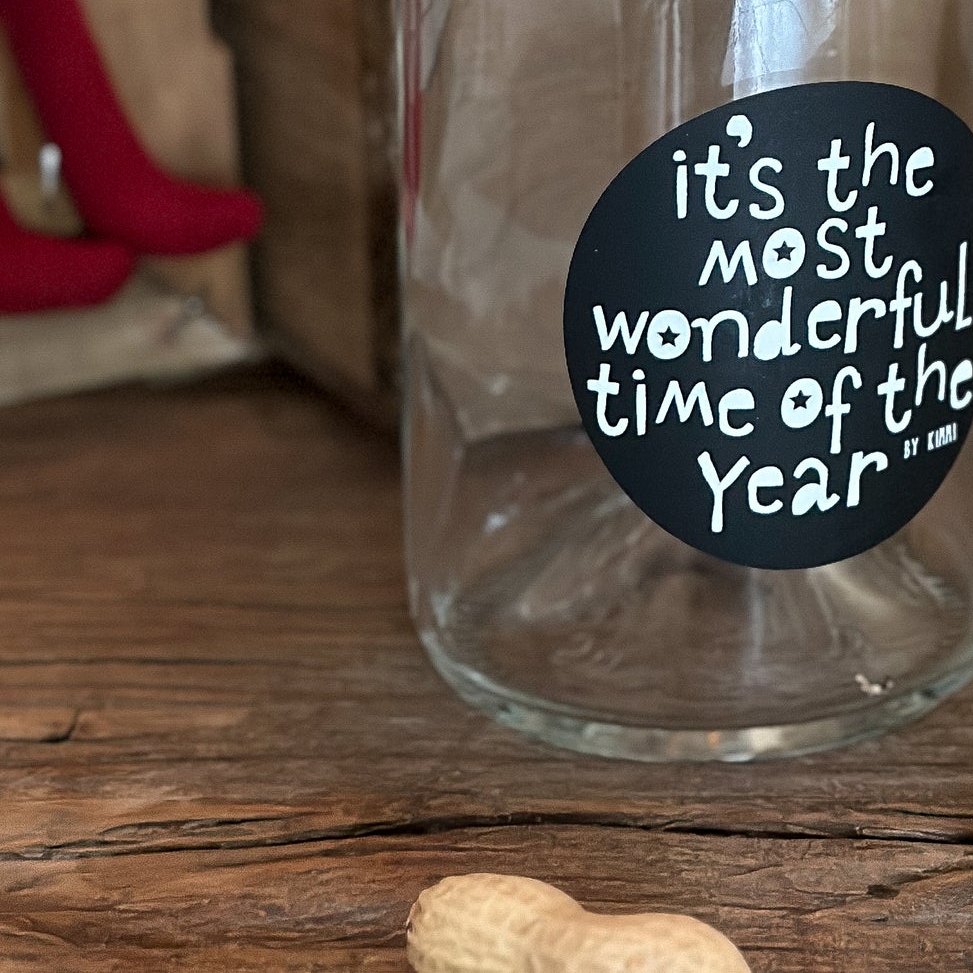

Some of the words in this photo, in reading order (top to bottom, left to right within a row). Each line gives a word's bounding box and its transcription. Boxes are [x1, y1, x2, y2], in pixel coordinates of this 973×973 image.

[673, 115, 785, 220] it's
[818, 122, 935, 213] the
[699, 206, 894, 286] most
[593, 242, 973, 363] wonderful
[587, 364, 755, 437] time
[781, 366, 863, 455] of
[878, 343, 973, 434] the
[903, 437, 919, 460] BY
